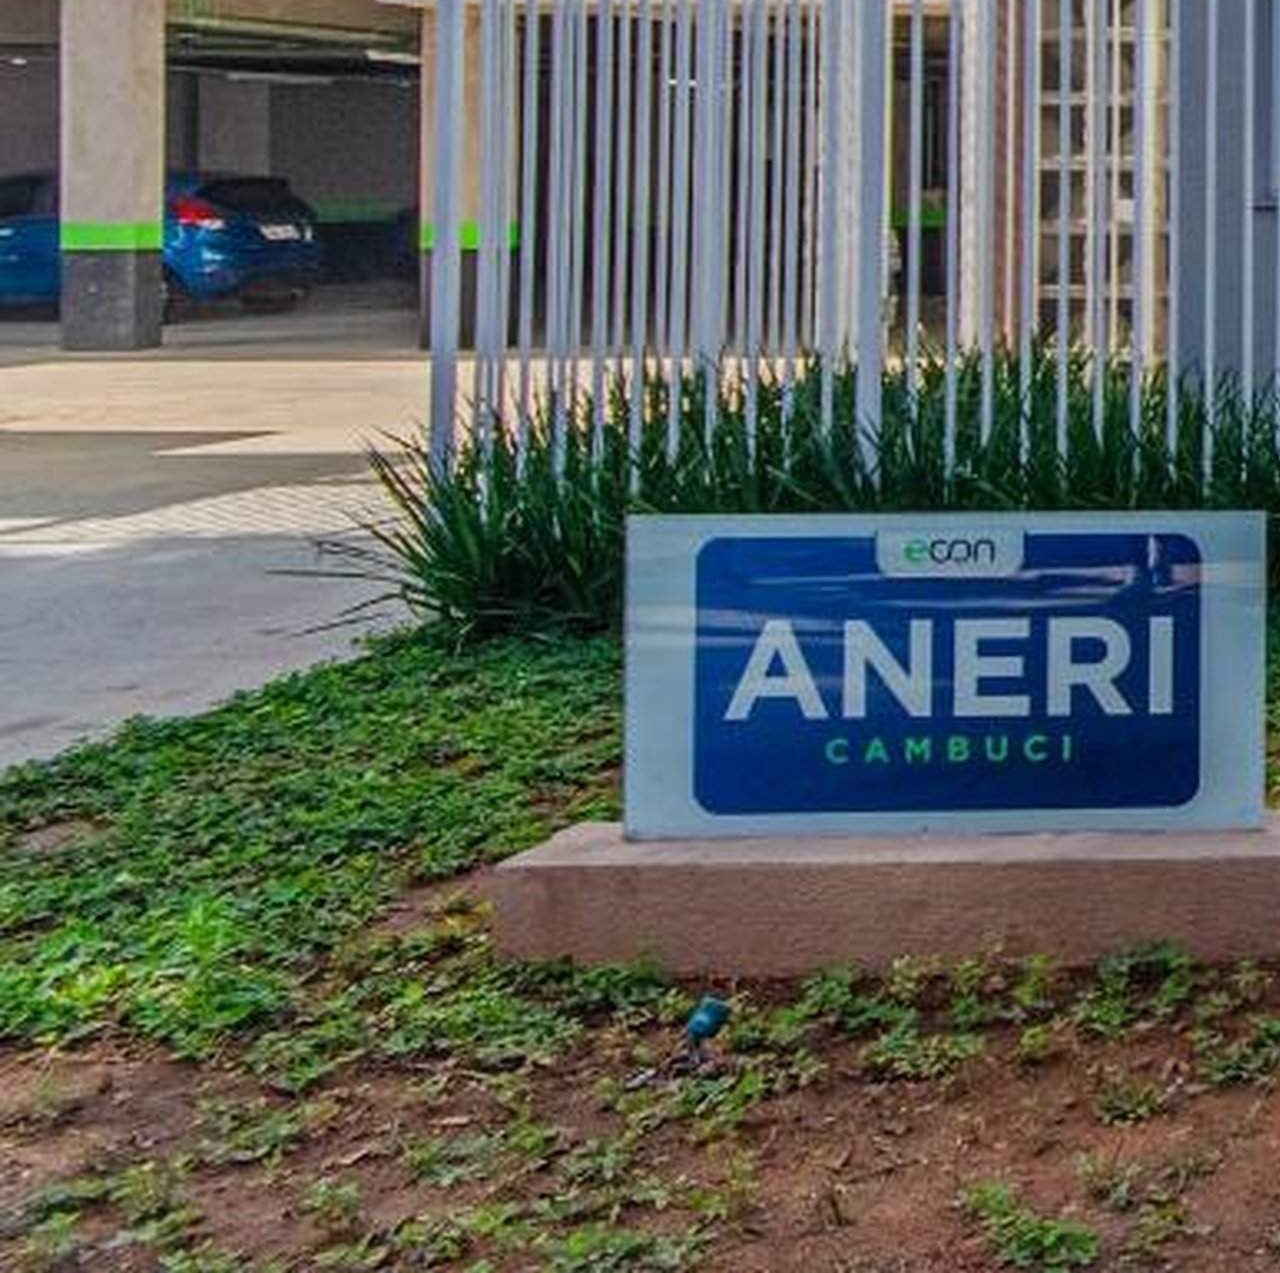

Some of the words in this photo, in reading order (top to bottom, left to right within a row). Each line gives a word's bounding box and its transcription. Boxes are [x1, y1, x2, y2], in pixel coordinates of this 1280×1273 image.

[902, 538, 995, 566] econ
[723, 617, 1173, 720] ANERI
[824, 734, 1073, 765] CAMBUCI
